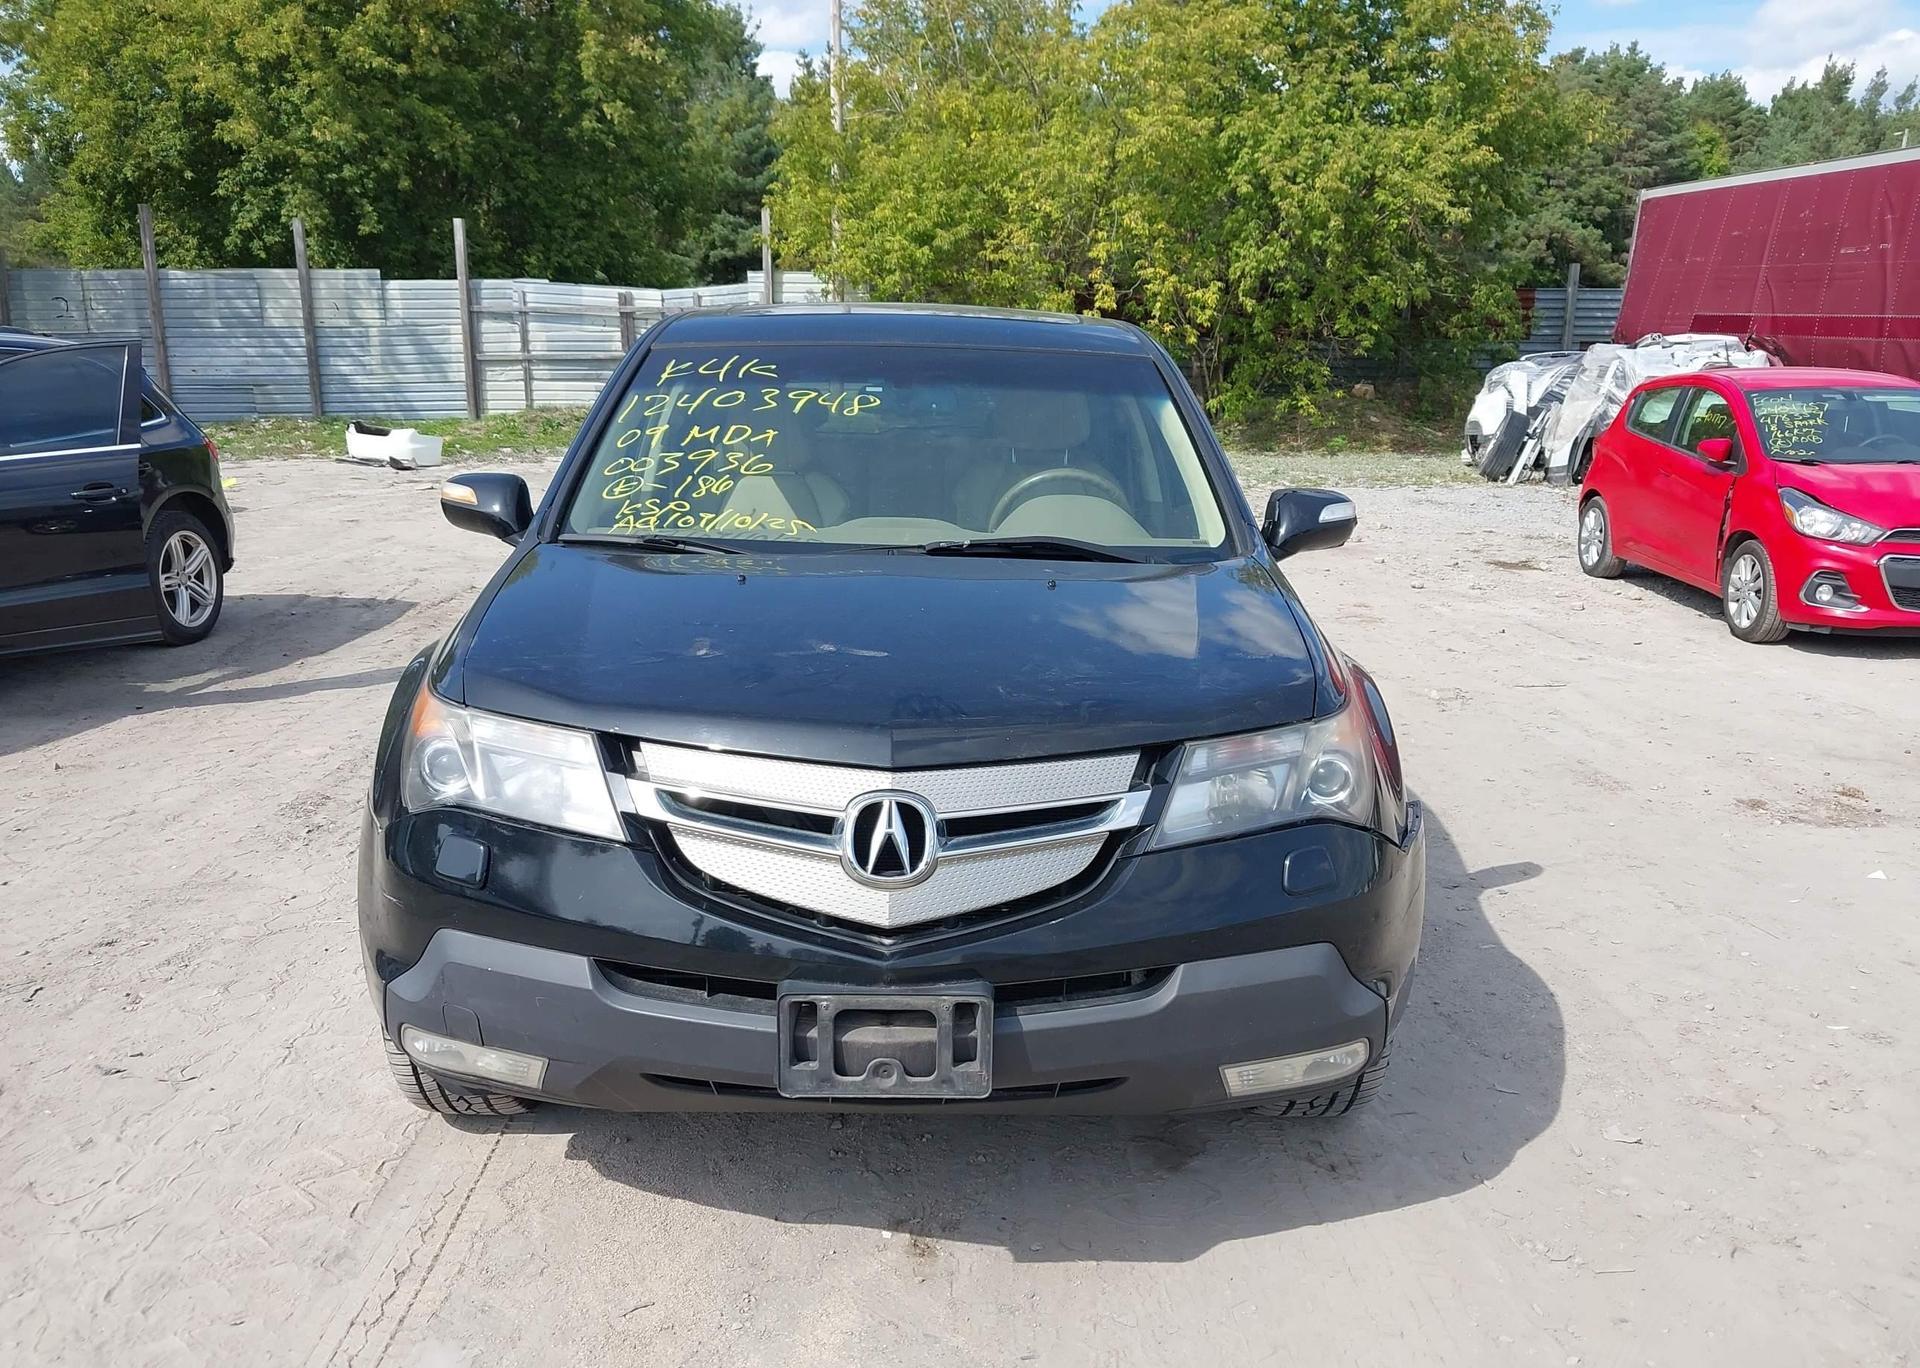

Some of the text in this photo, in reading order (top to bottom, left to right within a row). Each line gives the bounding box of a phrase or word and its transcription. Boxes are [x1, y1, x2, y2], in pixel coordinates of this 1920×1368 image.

[617, 387, 881, 424] 12403948
[616, 424, 669, 449] 09
[604, 449, 773, 475] 003936
